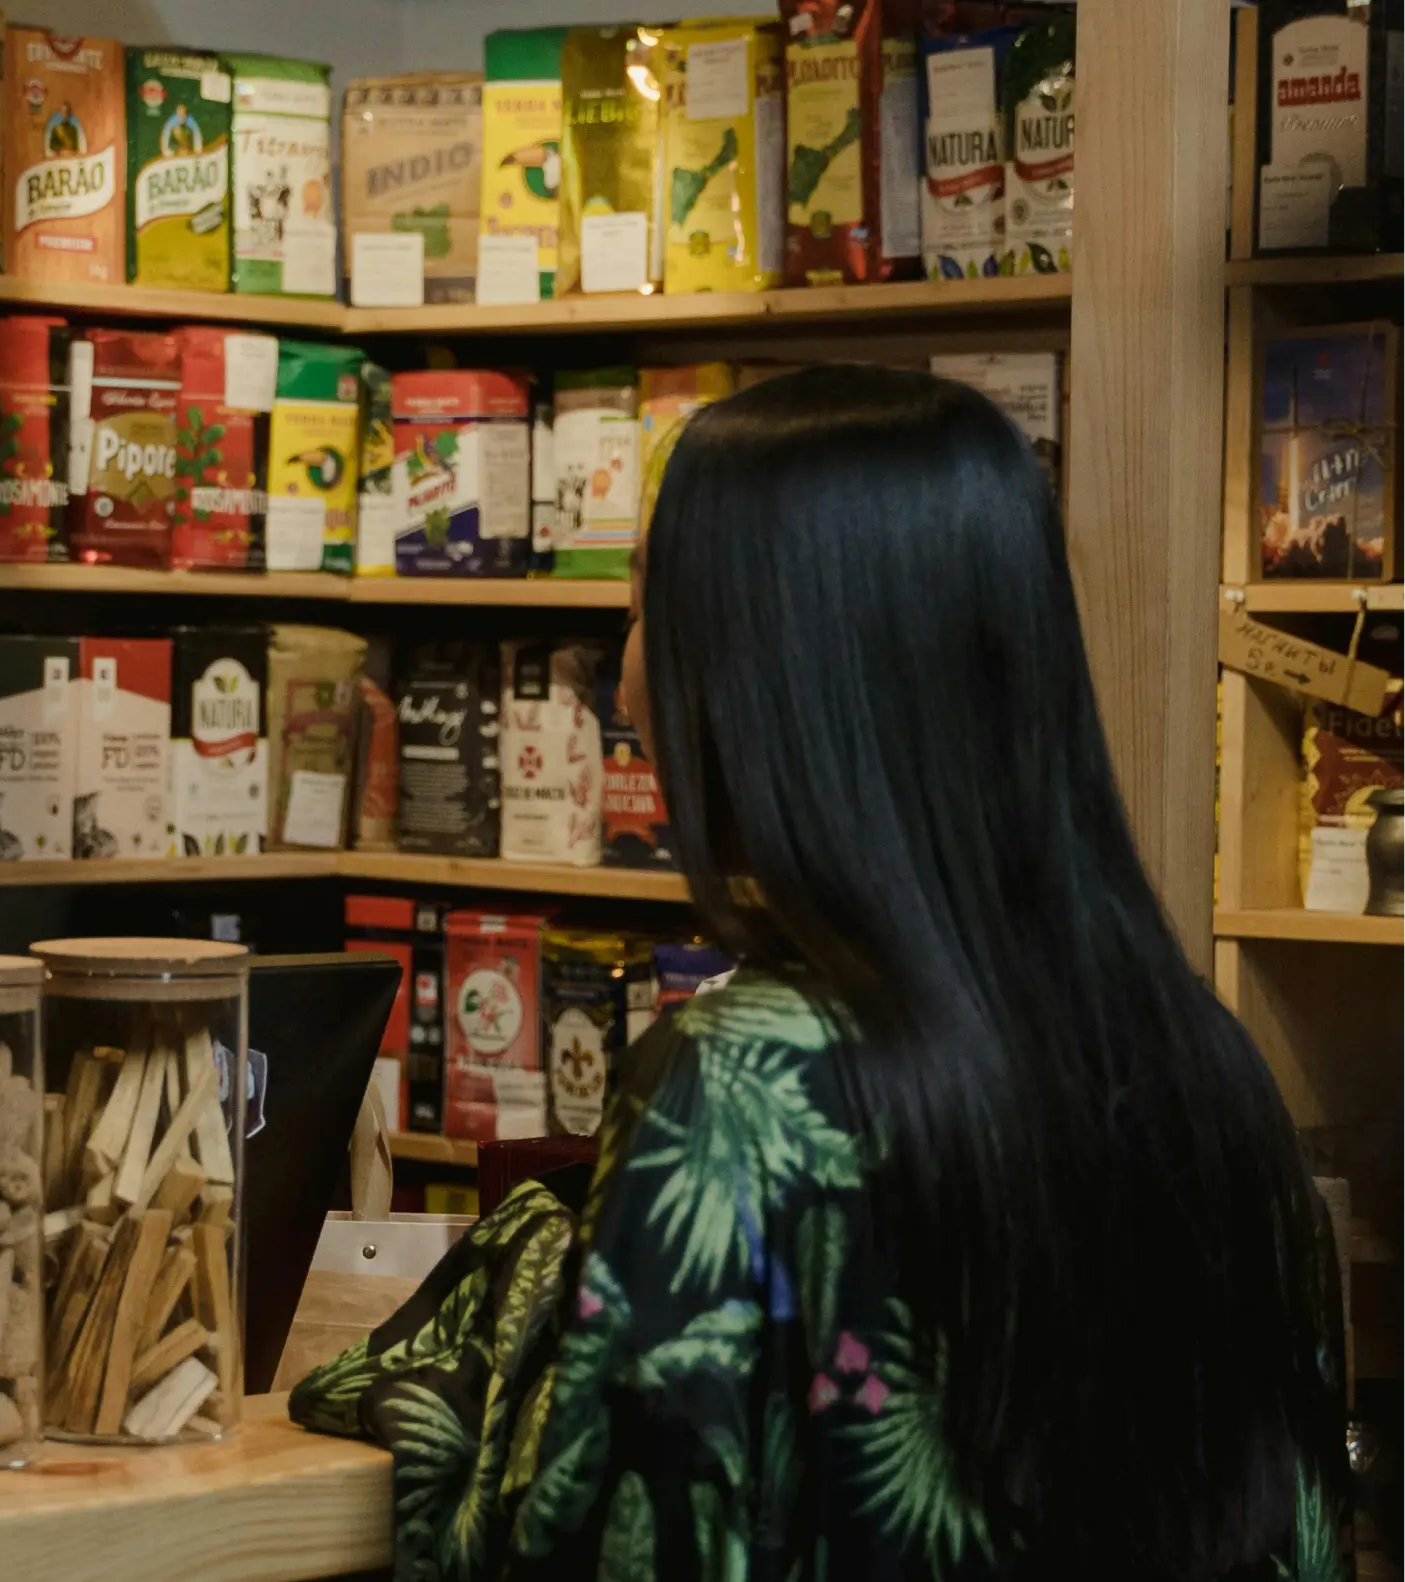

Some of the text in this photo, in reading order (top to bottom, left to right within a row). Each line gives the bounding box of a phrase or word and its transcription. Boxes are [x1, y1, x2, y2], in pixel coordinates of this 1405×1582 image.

[1277, 65, 1361, 107] amanda
[928, 129, 997, 167] NATURA
[27, 160, 105, 205] BARÃO
[147, 160, 219, 201] BARÃO
[367, 141, 475, 198] INDIO
